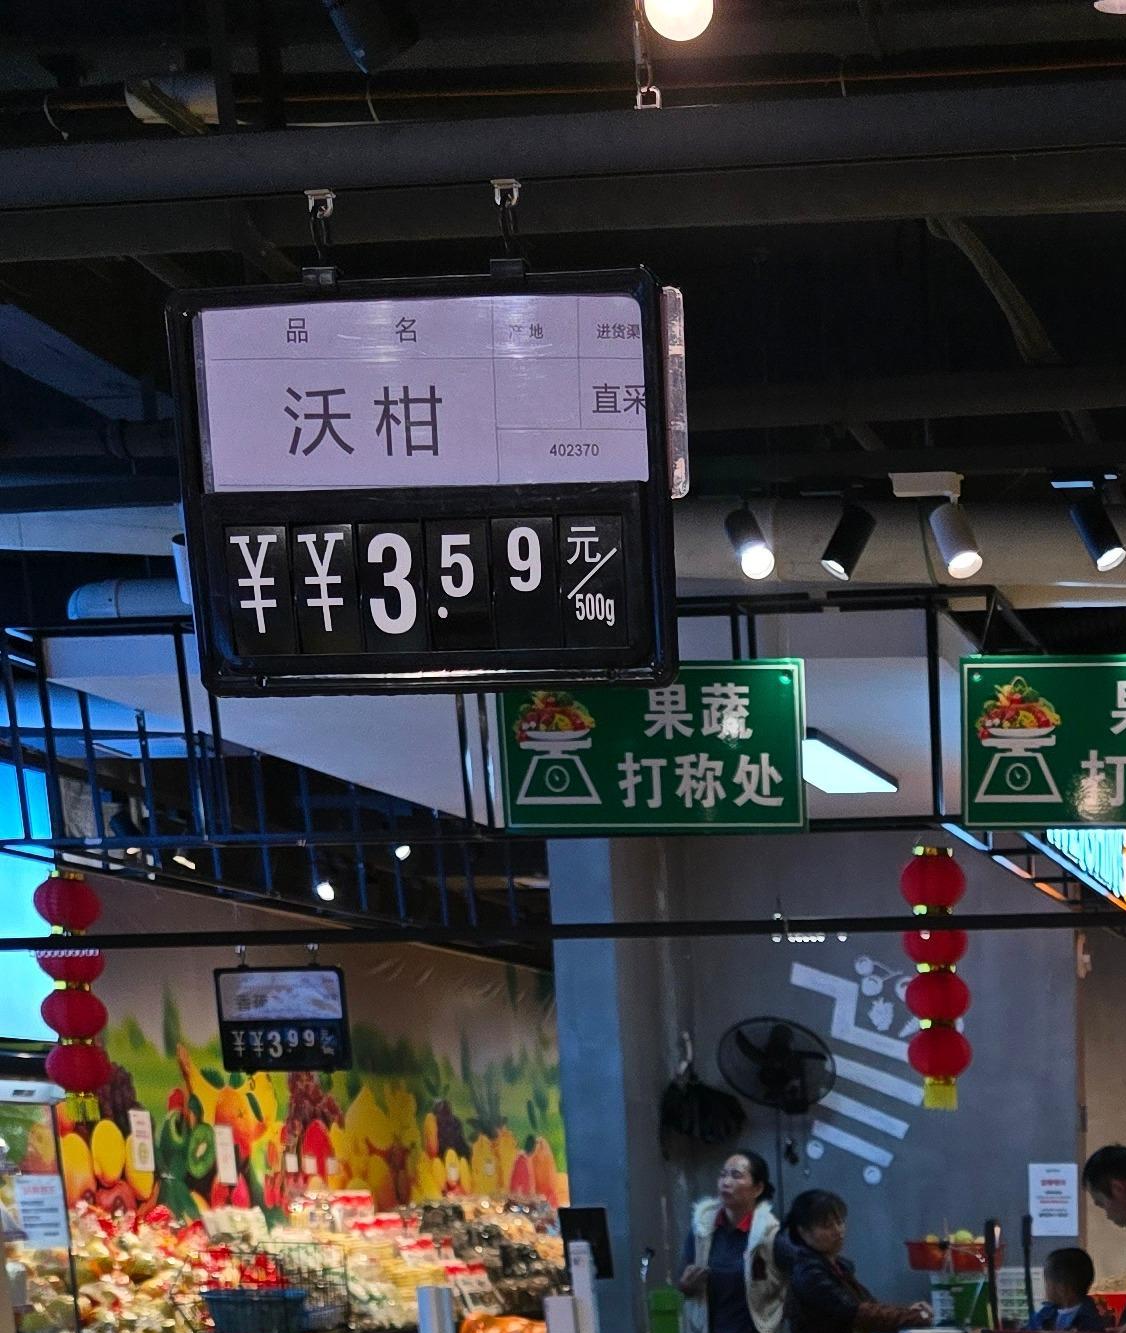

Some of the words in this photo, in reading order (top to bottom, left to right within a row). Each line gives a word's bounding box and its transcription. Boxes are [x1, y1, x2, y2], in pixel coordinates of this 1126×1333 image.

[284, 385, 443, 457] 沃柑
[592, 384, 647, 415] 直采
[549, 443, 600, 457] 402370
[642, 681, 755, 741] 果蔬
[617, 752, 785, 810] 打称处
